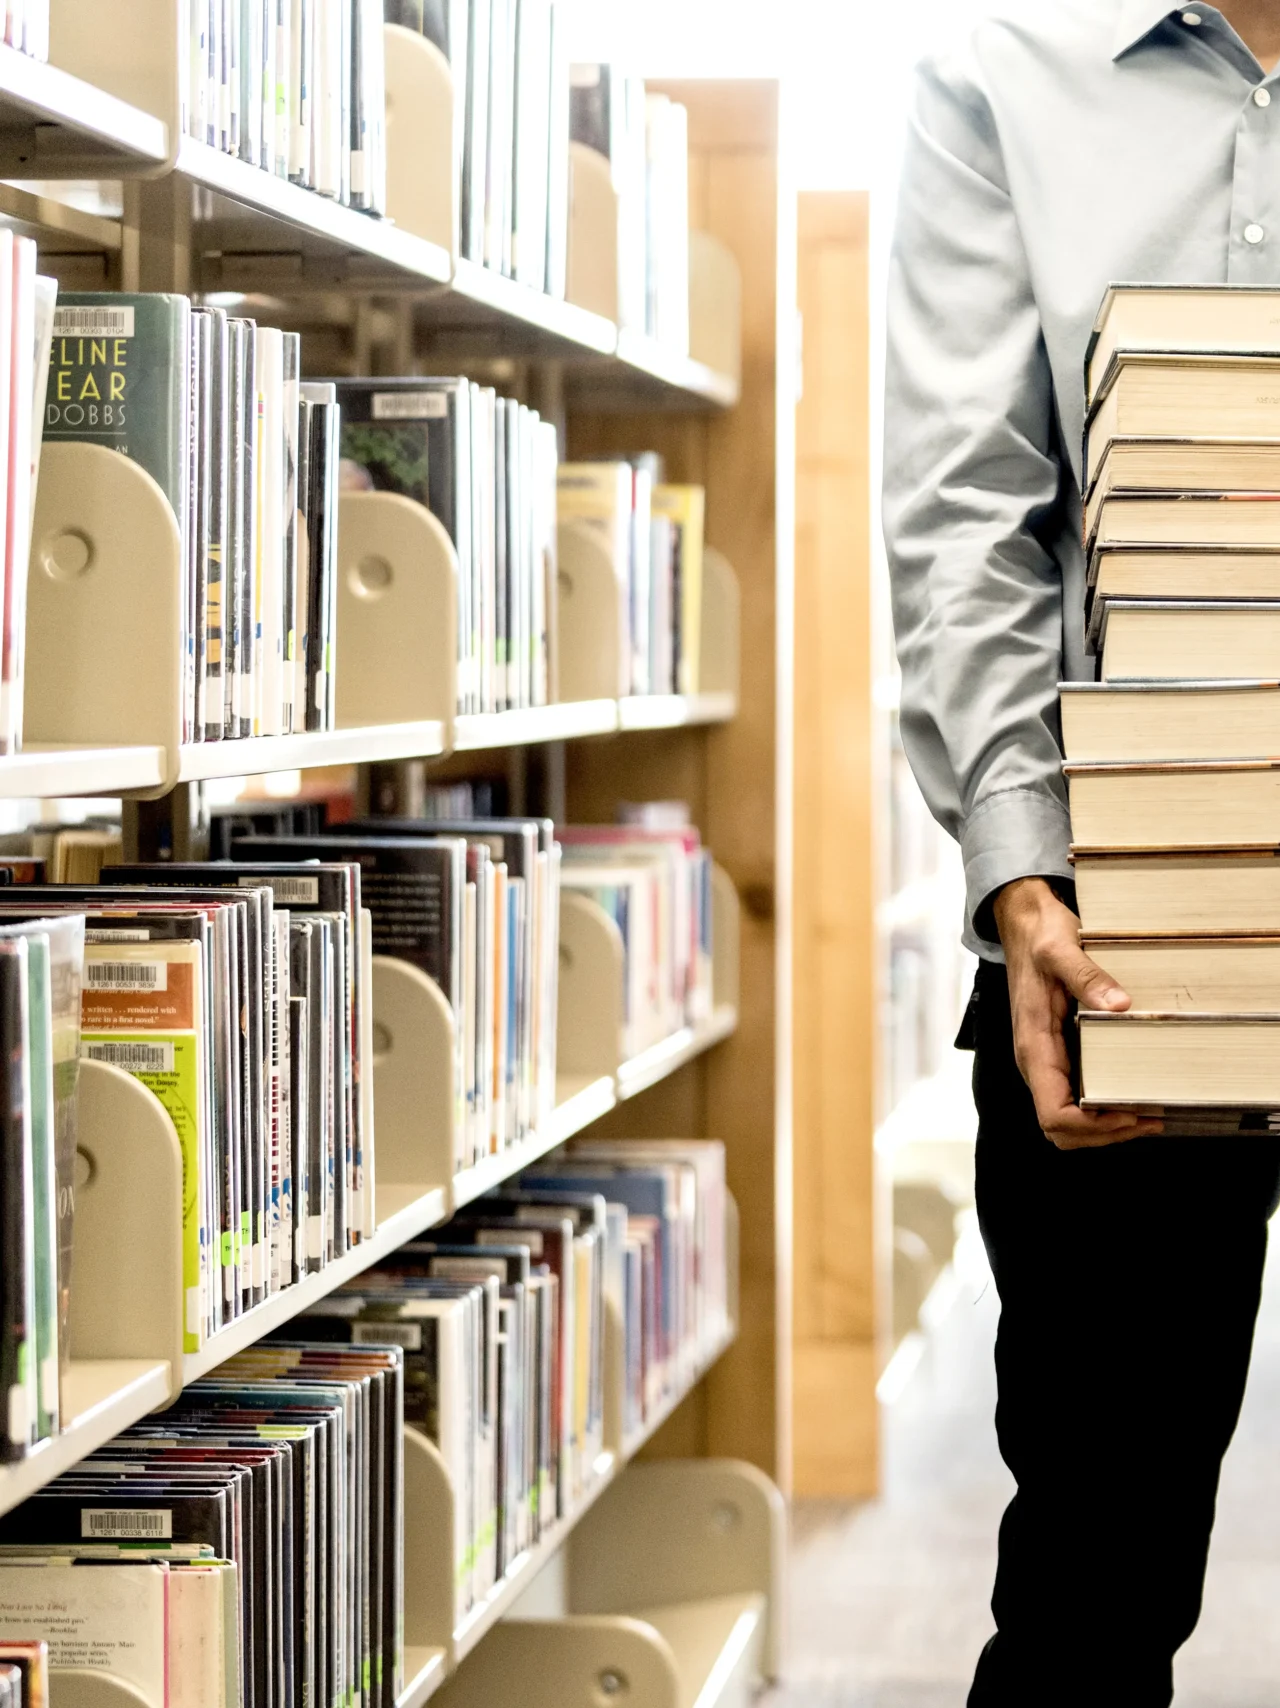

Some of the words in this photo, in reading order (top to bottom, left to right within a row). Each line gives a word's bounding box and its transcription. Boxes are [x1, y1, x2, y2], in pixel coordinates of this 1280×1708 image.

[58, 371, 127, 401] EAR
[47, 403, 127, 426] DOBBS
[127, 1006, 159, 1014] rendered
[47, 1604, 68, 1612] Long
[61, 1640, 89, 1648] barrister
[91, 1641, 116, 1649] Antony
[88, 1658, 111, 1666] Weekly
